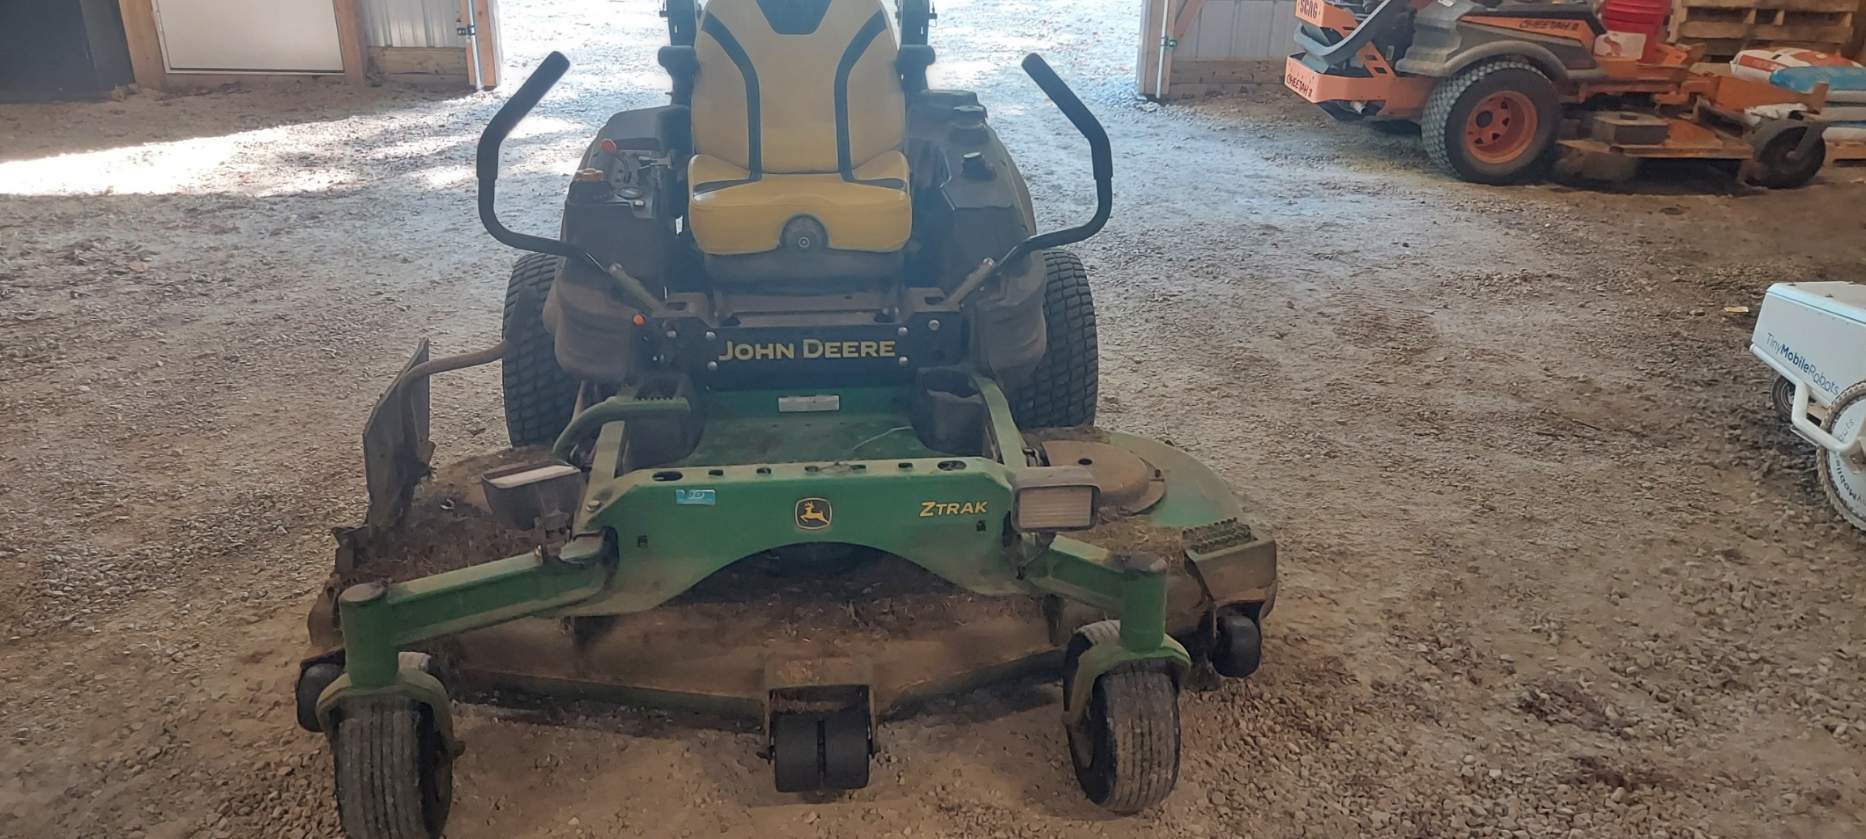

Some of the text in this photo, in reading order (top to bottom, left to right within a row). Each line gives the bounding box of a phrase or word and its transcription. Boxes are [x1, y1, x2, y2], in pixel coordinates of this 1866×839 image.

[1286, 73, 1308, 96] CHEETAH
[719, 339, 896, 361] JOHN DEERE
[1766, 332, 1840, 396] TinyMobileRobots
[919, 500, 988, 517] ZTRAK
